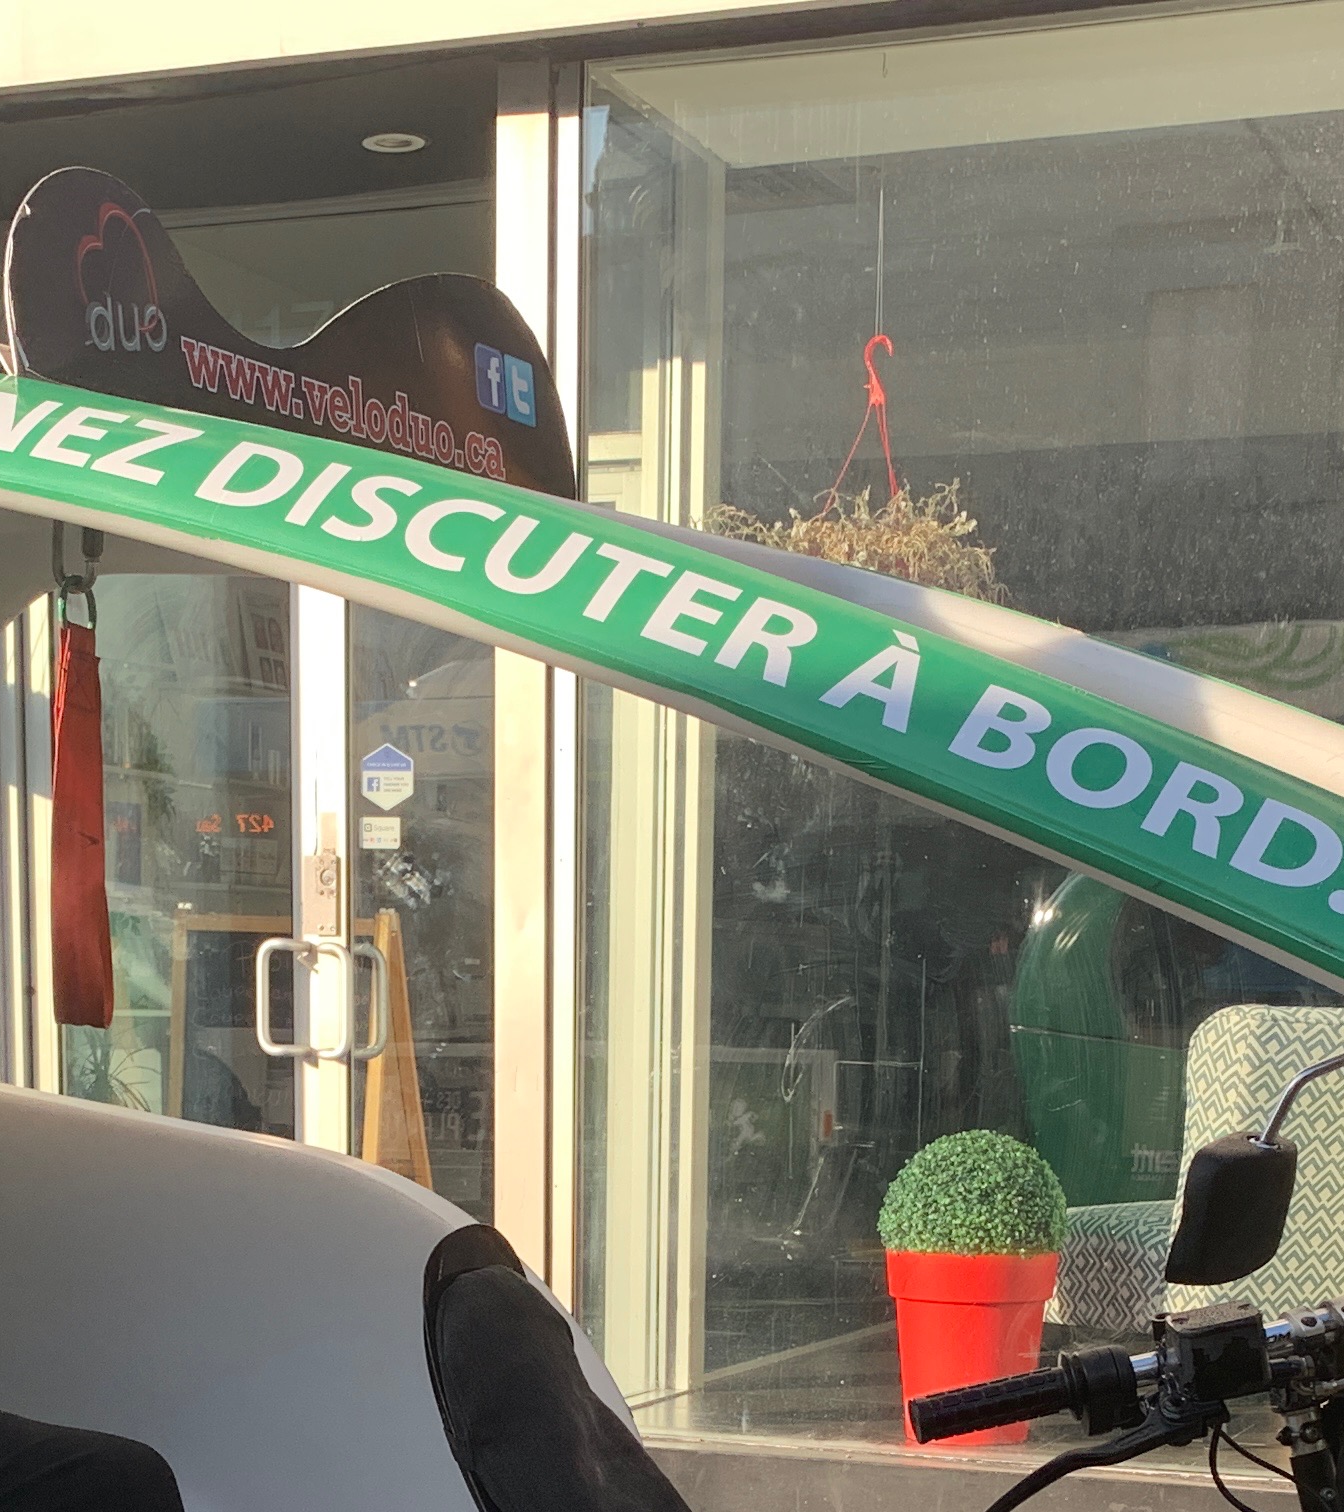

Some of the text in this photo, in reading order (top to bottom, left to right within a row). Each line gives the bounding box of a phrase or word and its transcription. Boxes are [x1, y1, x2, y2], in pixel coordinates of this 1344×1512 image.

[85, 292, 167, 353] duo
[181, 337, 505, 481] www.veloduo.ca
[195, 441, 818, 686] DISCUTER
[820, 629, 922, 733] À
